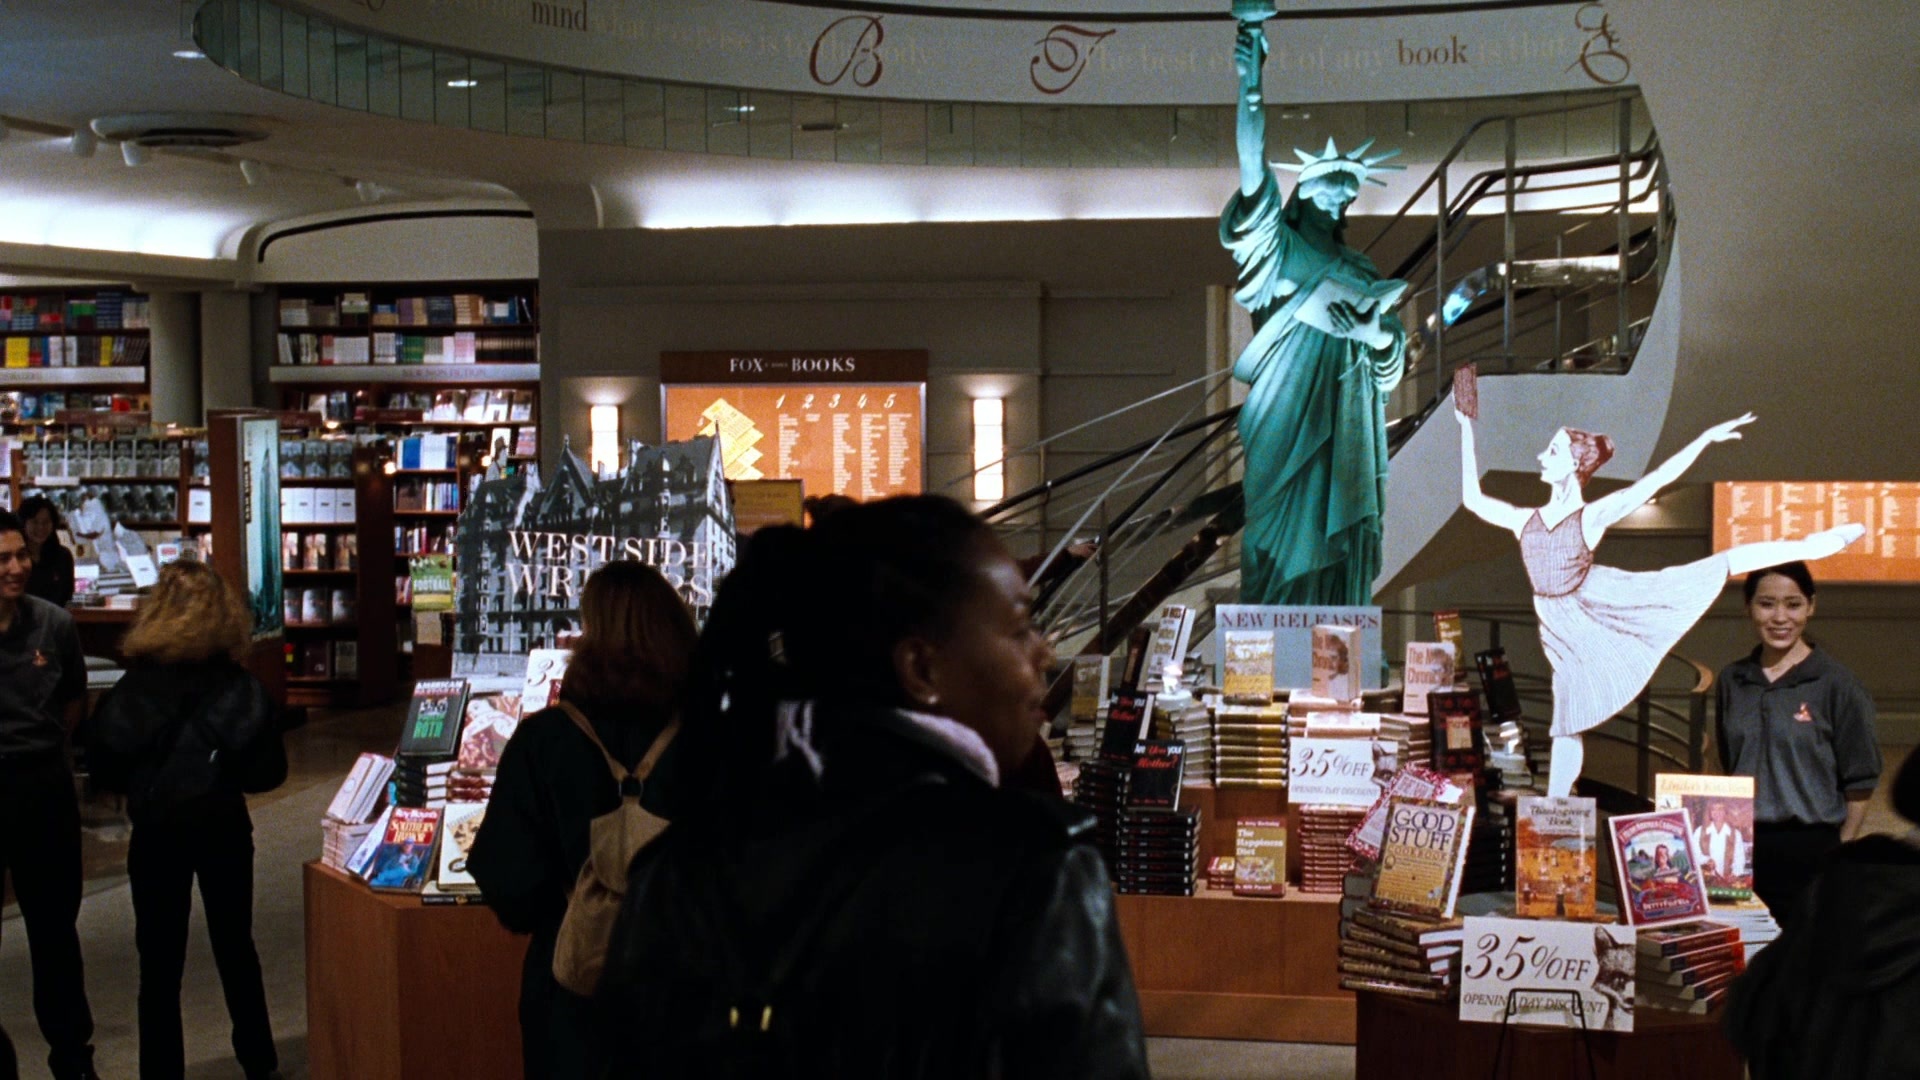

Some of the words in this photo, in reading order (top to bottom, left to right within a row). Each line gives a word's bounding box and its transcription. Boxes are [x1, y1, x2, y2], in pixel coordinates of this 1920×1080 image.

[531, 0, 588, 31] mind
[1396, 35, 1470, 66] book
[730, 358, 763, 373] FOX
[791, 358, 856, 373] BOOKS
[776, 394, 786, 409] 1
[802, 394, 815, 409] 2
[829, 394, 842, 409] 3
[856, 394, 868, 409] 4
[884, 394, 897, 409] 5
[508, 530, 616, 562] WEST
[623, 536, 709, 569] SIDE
[1221, 612, 1268, 629] NEW
[1273, 612, 1379, 629] RELEASES
[1394, 808, 1455, 833] GOOD
[1389, 826, 1452, 851] STUFF
[1518, 996, 1544, 1010] DAY
